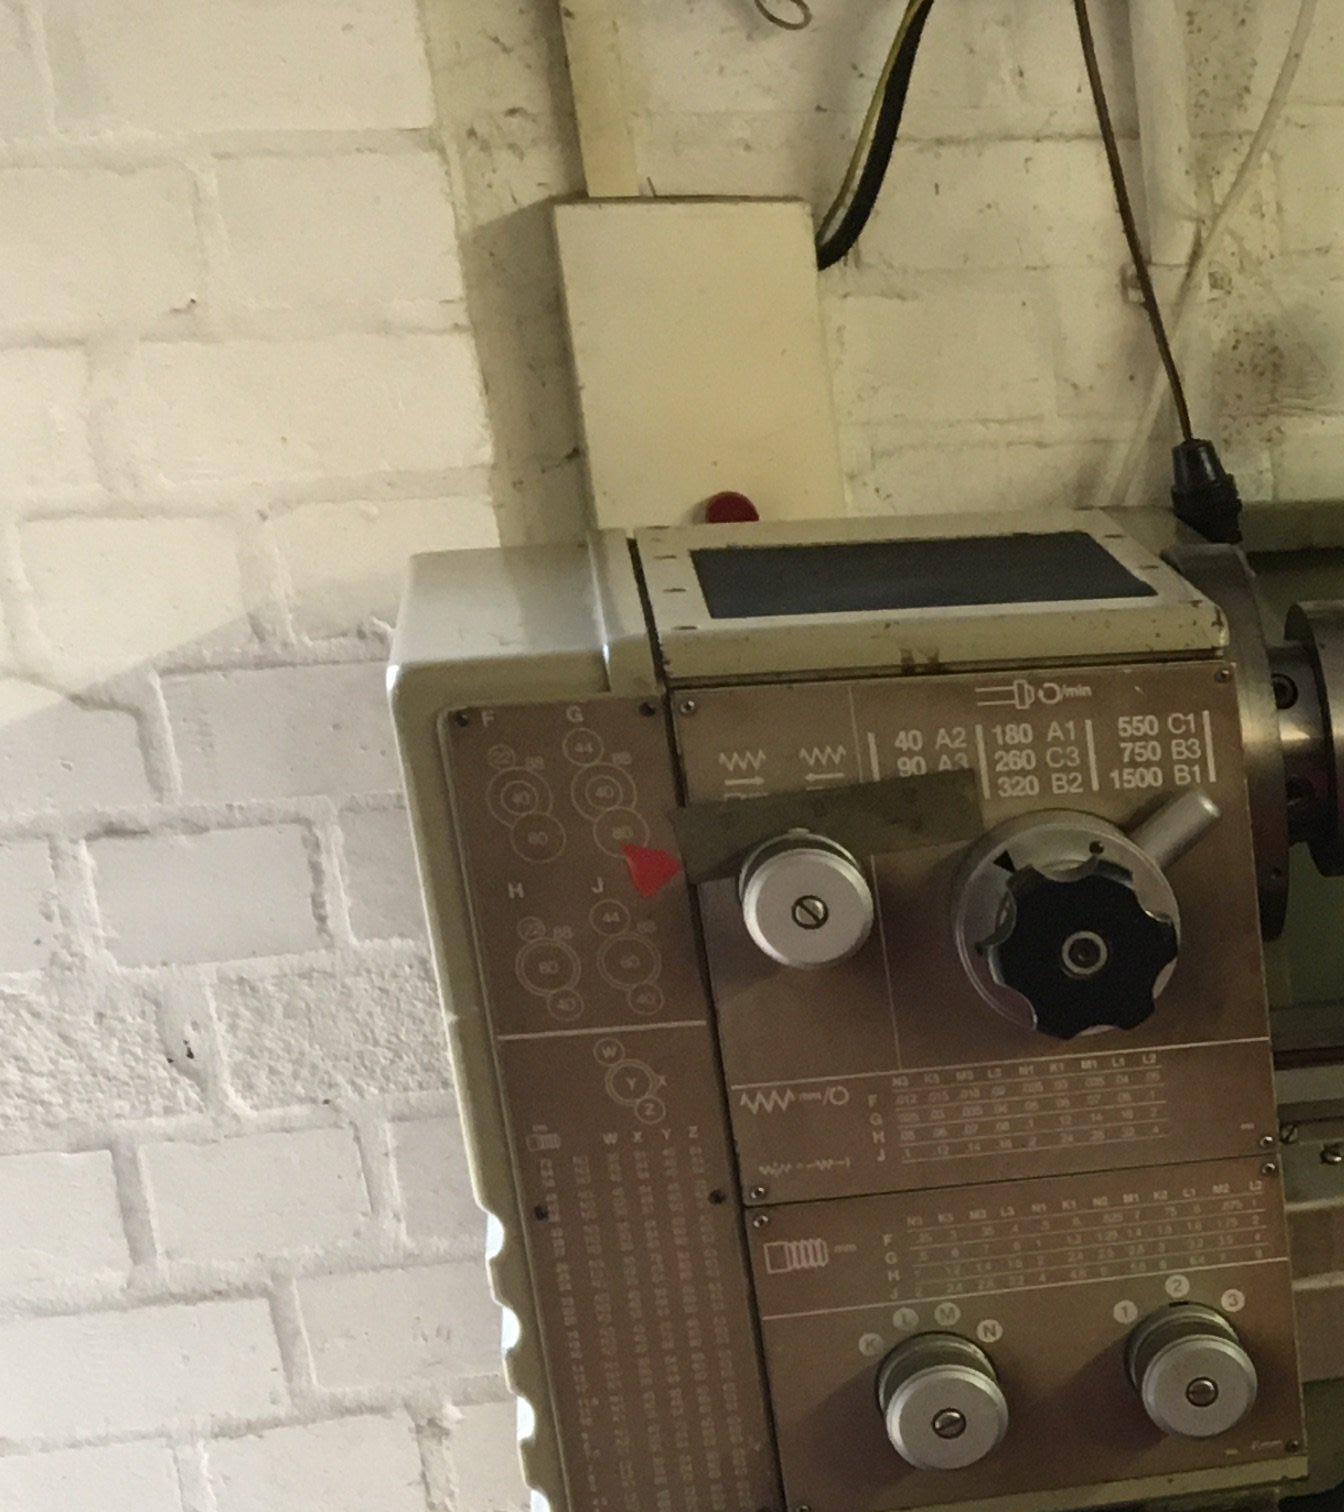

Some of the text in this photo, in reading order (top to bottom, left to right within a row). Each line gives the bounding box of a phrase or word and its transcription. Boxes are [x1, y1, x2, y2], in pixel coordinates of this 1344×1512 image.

[481, 710, 495, 728] F
[566, 705, 584, 723] G
[1118, 713, 1196, 737] 550 C1
[894, 728, 966, 751] 40 A2
[993, 721, 1076, 745] 180 A1
[995, 748, 1080, 772] 260 C3
[1121, 739, 1200, 762] 750 B3
[897, 757, 926, 776] 90
[1110, 765, 1201, 789] 1500 B1
[998, 773, 1083, 797] 320 B2
[507, 882, 524, 898] H
[591, 877, 604, 893] J
